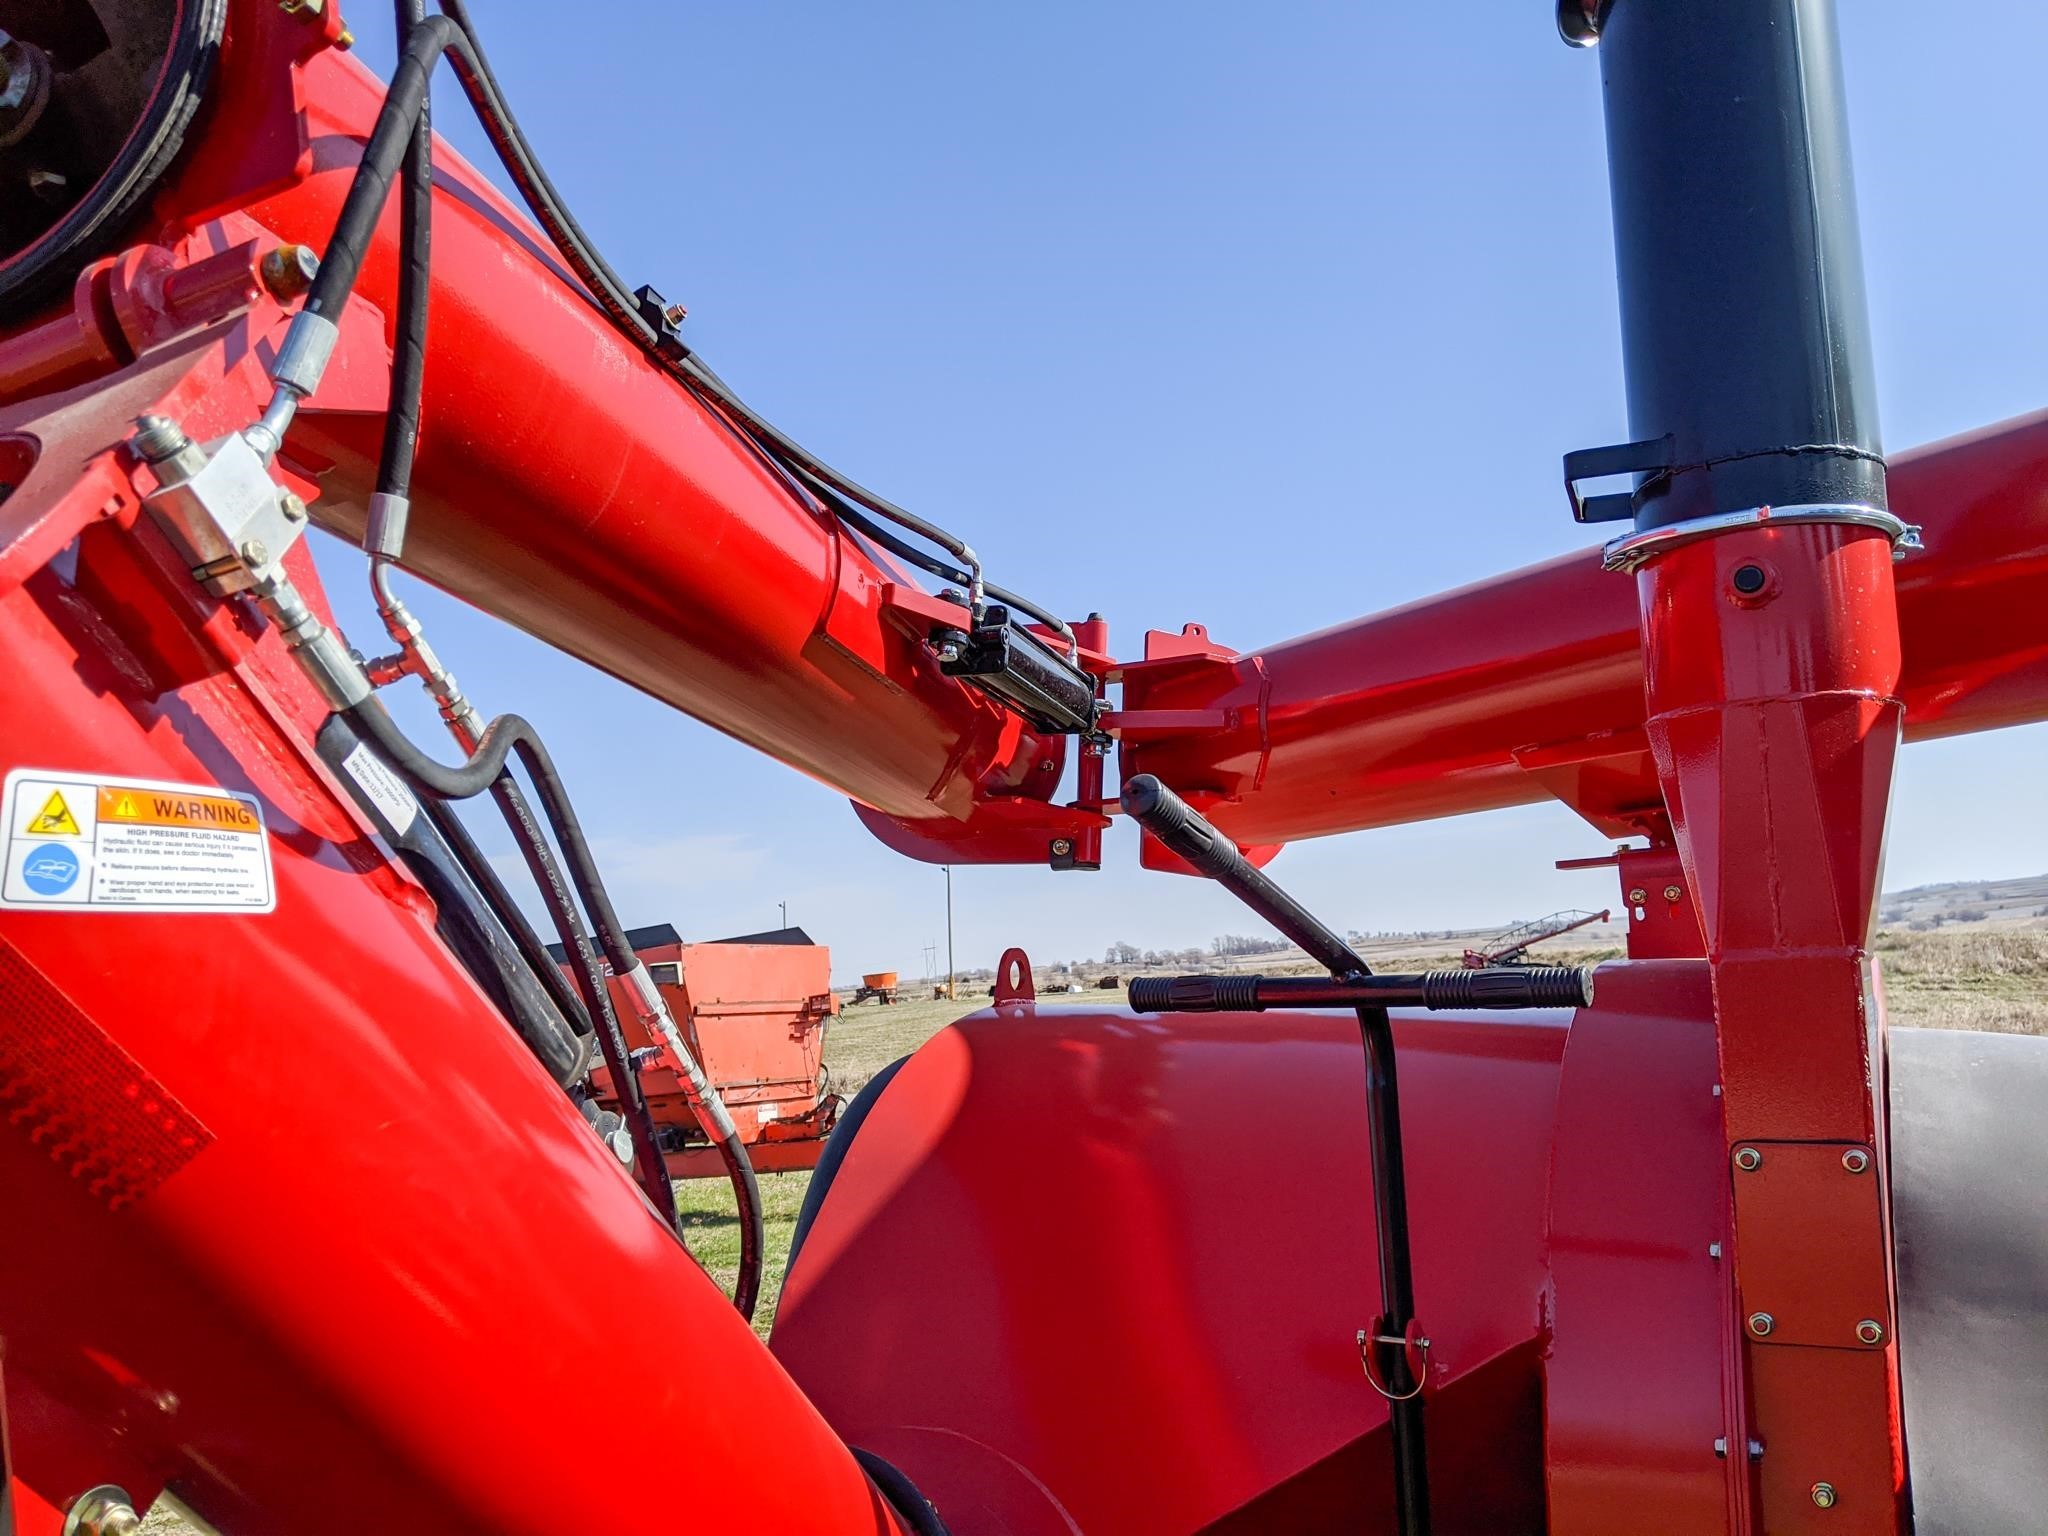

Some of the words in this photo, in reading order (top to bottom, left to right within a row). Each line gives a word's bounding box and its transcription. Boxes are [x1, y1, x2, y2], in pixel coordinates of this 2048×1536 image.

[153, 798, 251, 825] WARNING
[127, 828, 148, 836] HIGH
[149, 829, 189, 839] PRESSURE
[191, 832, 211, 840] FLUID
[213, 834, 239, 842] HAZARD
